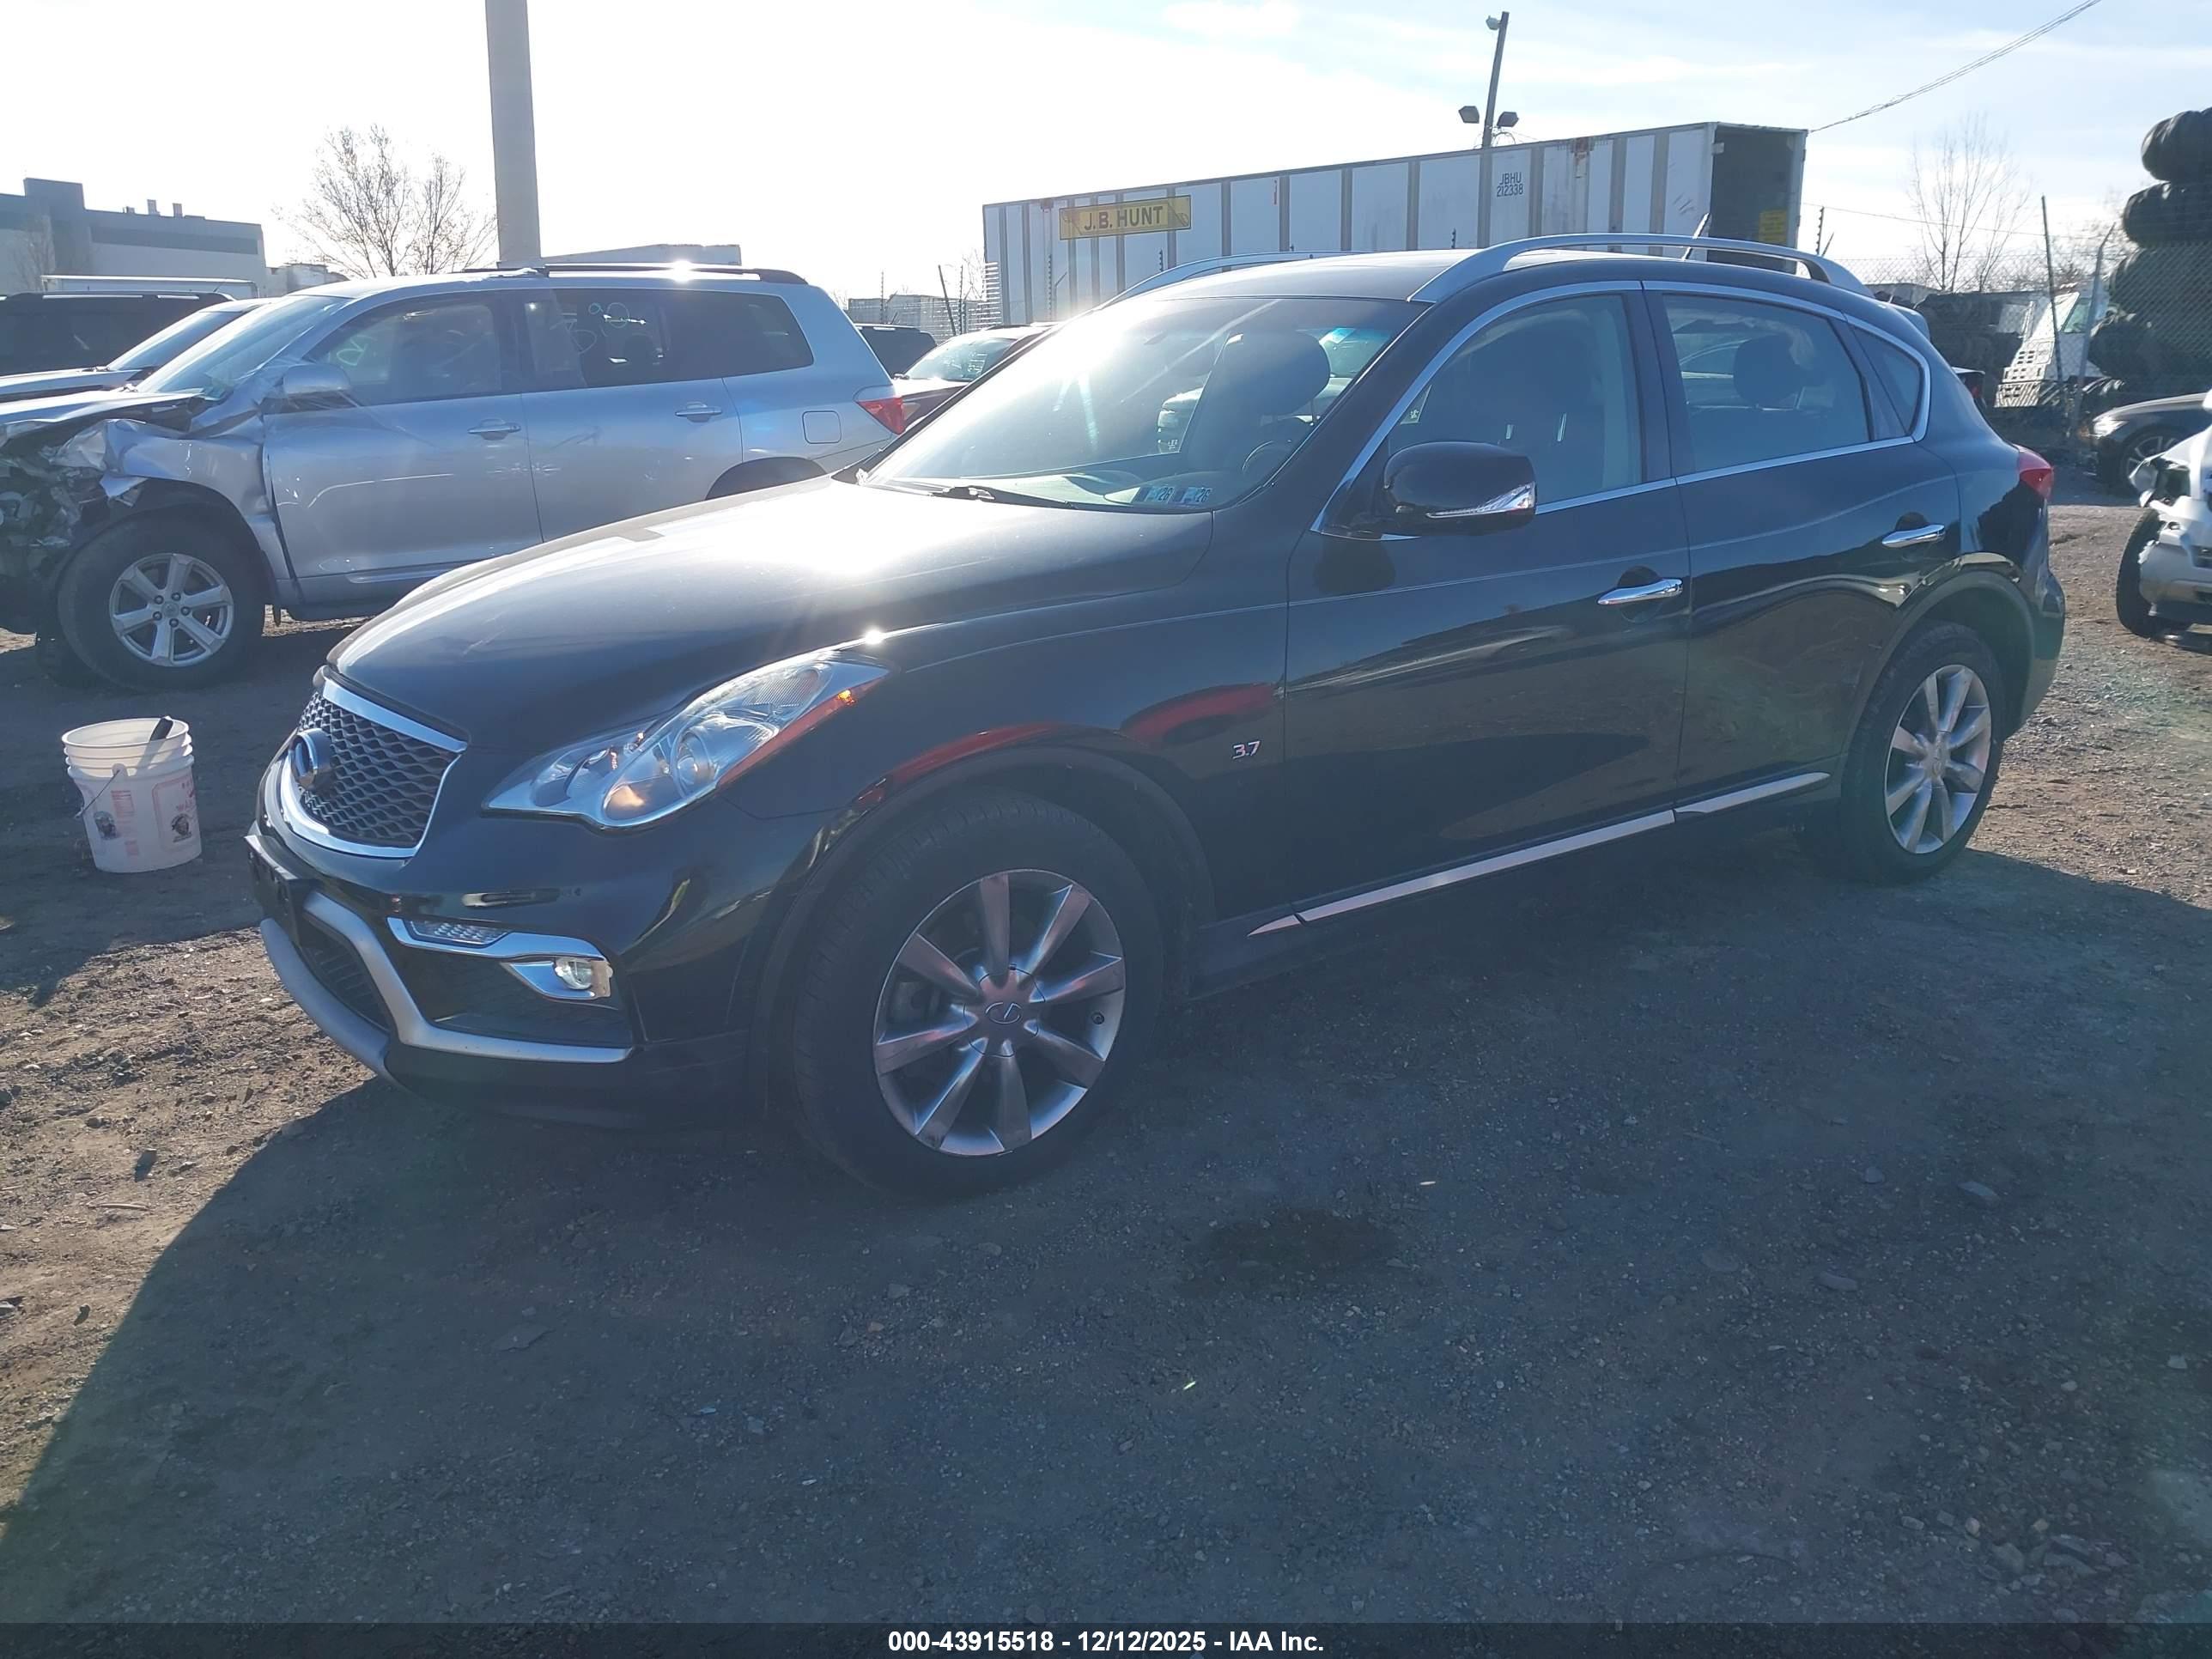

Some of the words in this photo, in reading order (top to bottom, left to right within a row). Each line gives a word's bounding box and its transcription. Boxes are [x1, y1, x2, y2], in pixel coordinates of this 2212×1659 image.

[1499, 172, 1522, 185] JBHU
[1497, 183, 1523, 197] 212338
[1084, 211, 1113, 231] J.B.
[1117, 205, 1164, 228] HUNT
[1232, 740, 1261, 760] 3.7
